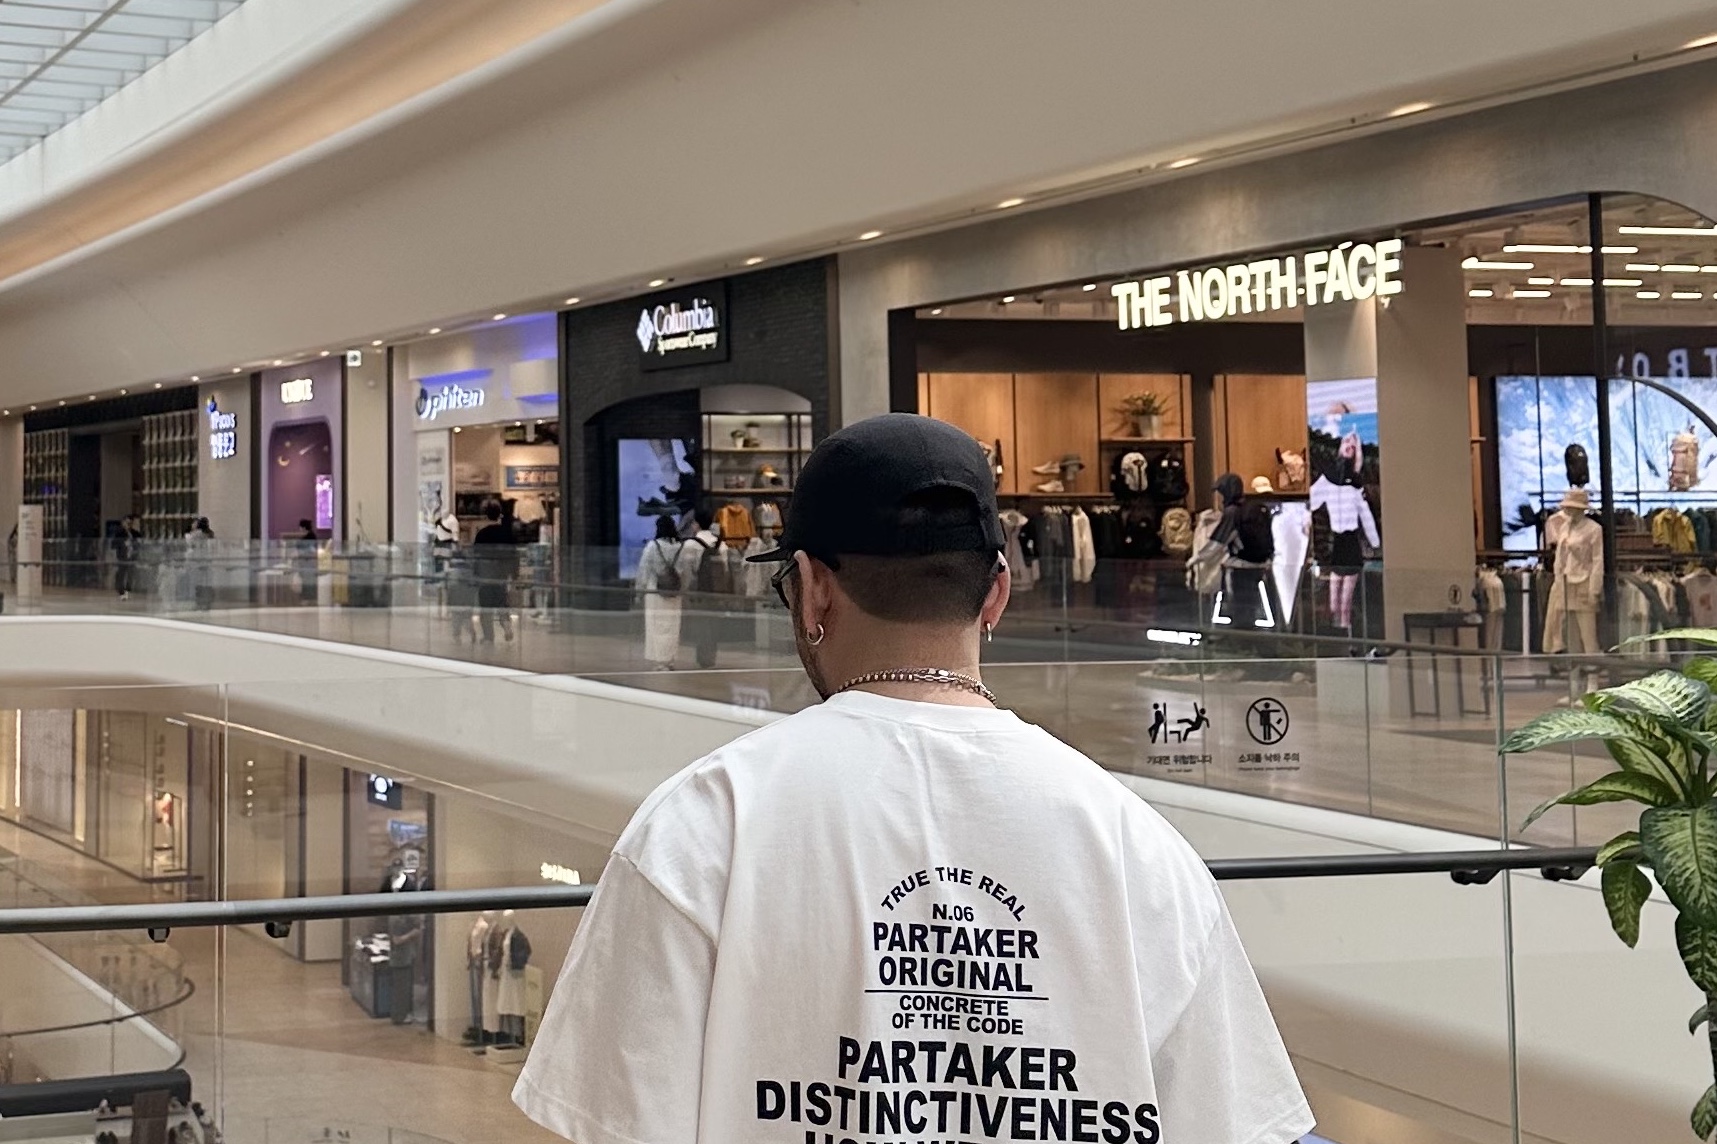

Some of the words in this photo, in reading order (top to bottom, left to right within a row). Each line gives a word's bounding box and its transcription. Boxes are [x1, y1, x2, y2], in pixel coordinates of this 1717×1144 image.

[1111, 276, 1173, 330] THE
[1176, 256, 1298, 322] NORTH
[1304, 239, 1402, 306] FACE
[653, 297, 715, 335] Columbia
[881, 869, 930, 911] TRUE
[935, 866, 974, 886] THE
[978, 875, 1026, 922] REAL
[932, 903, 974, 922] N.06
[873, 922, 1040, 959] PARTAKER
[879, 955, 1033, 992] ORIGINAL
[892, 1013, 915, 1029] OF
[920, 1013, 961, 1030] THE
[966, 1017, 1024, 1035] CODE
[899, 995, 1009, 1016] CONCRETE
[838, 1035, 1079, 1092] PARTAKER
